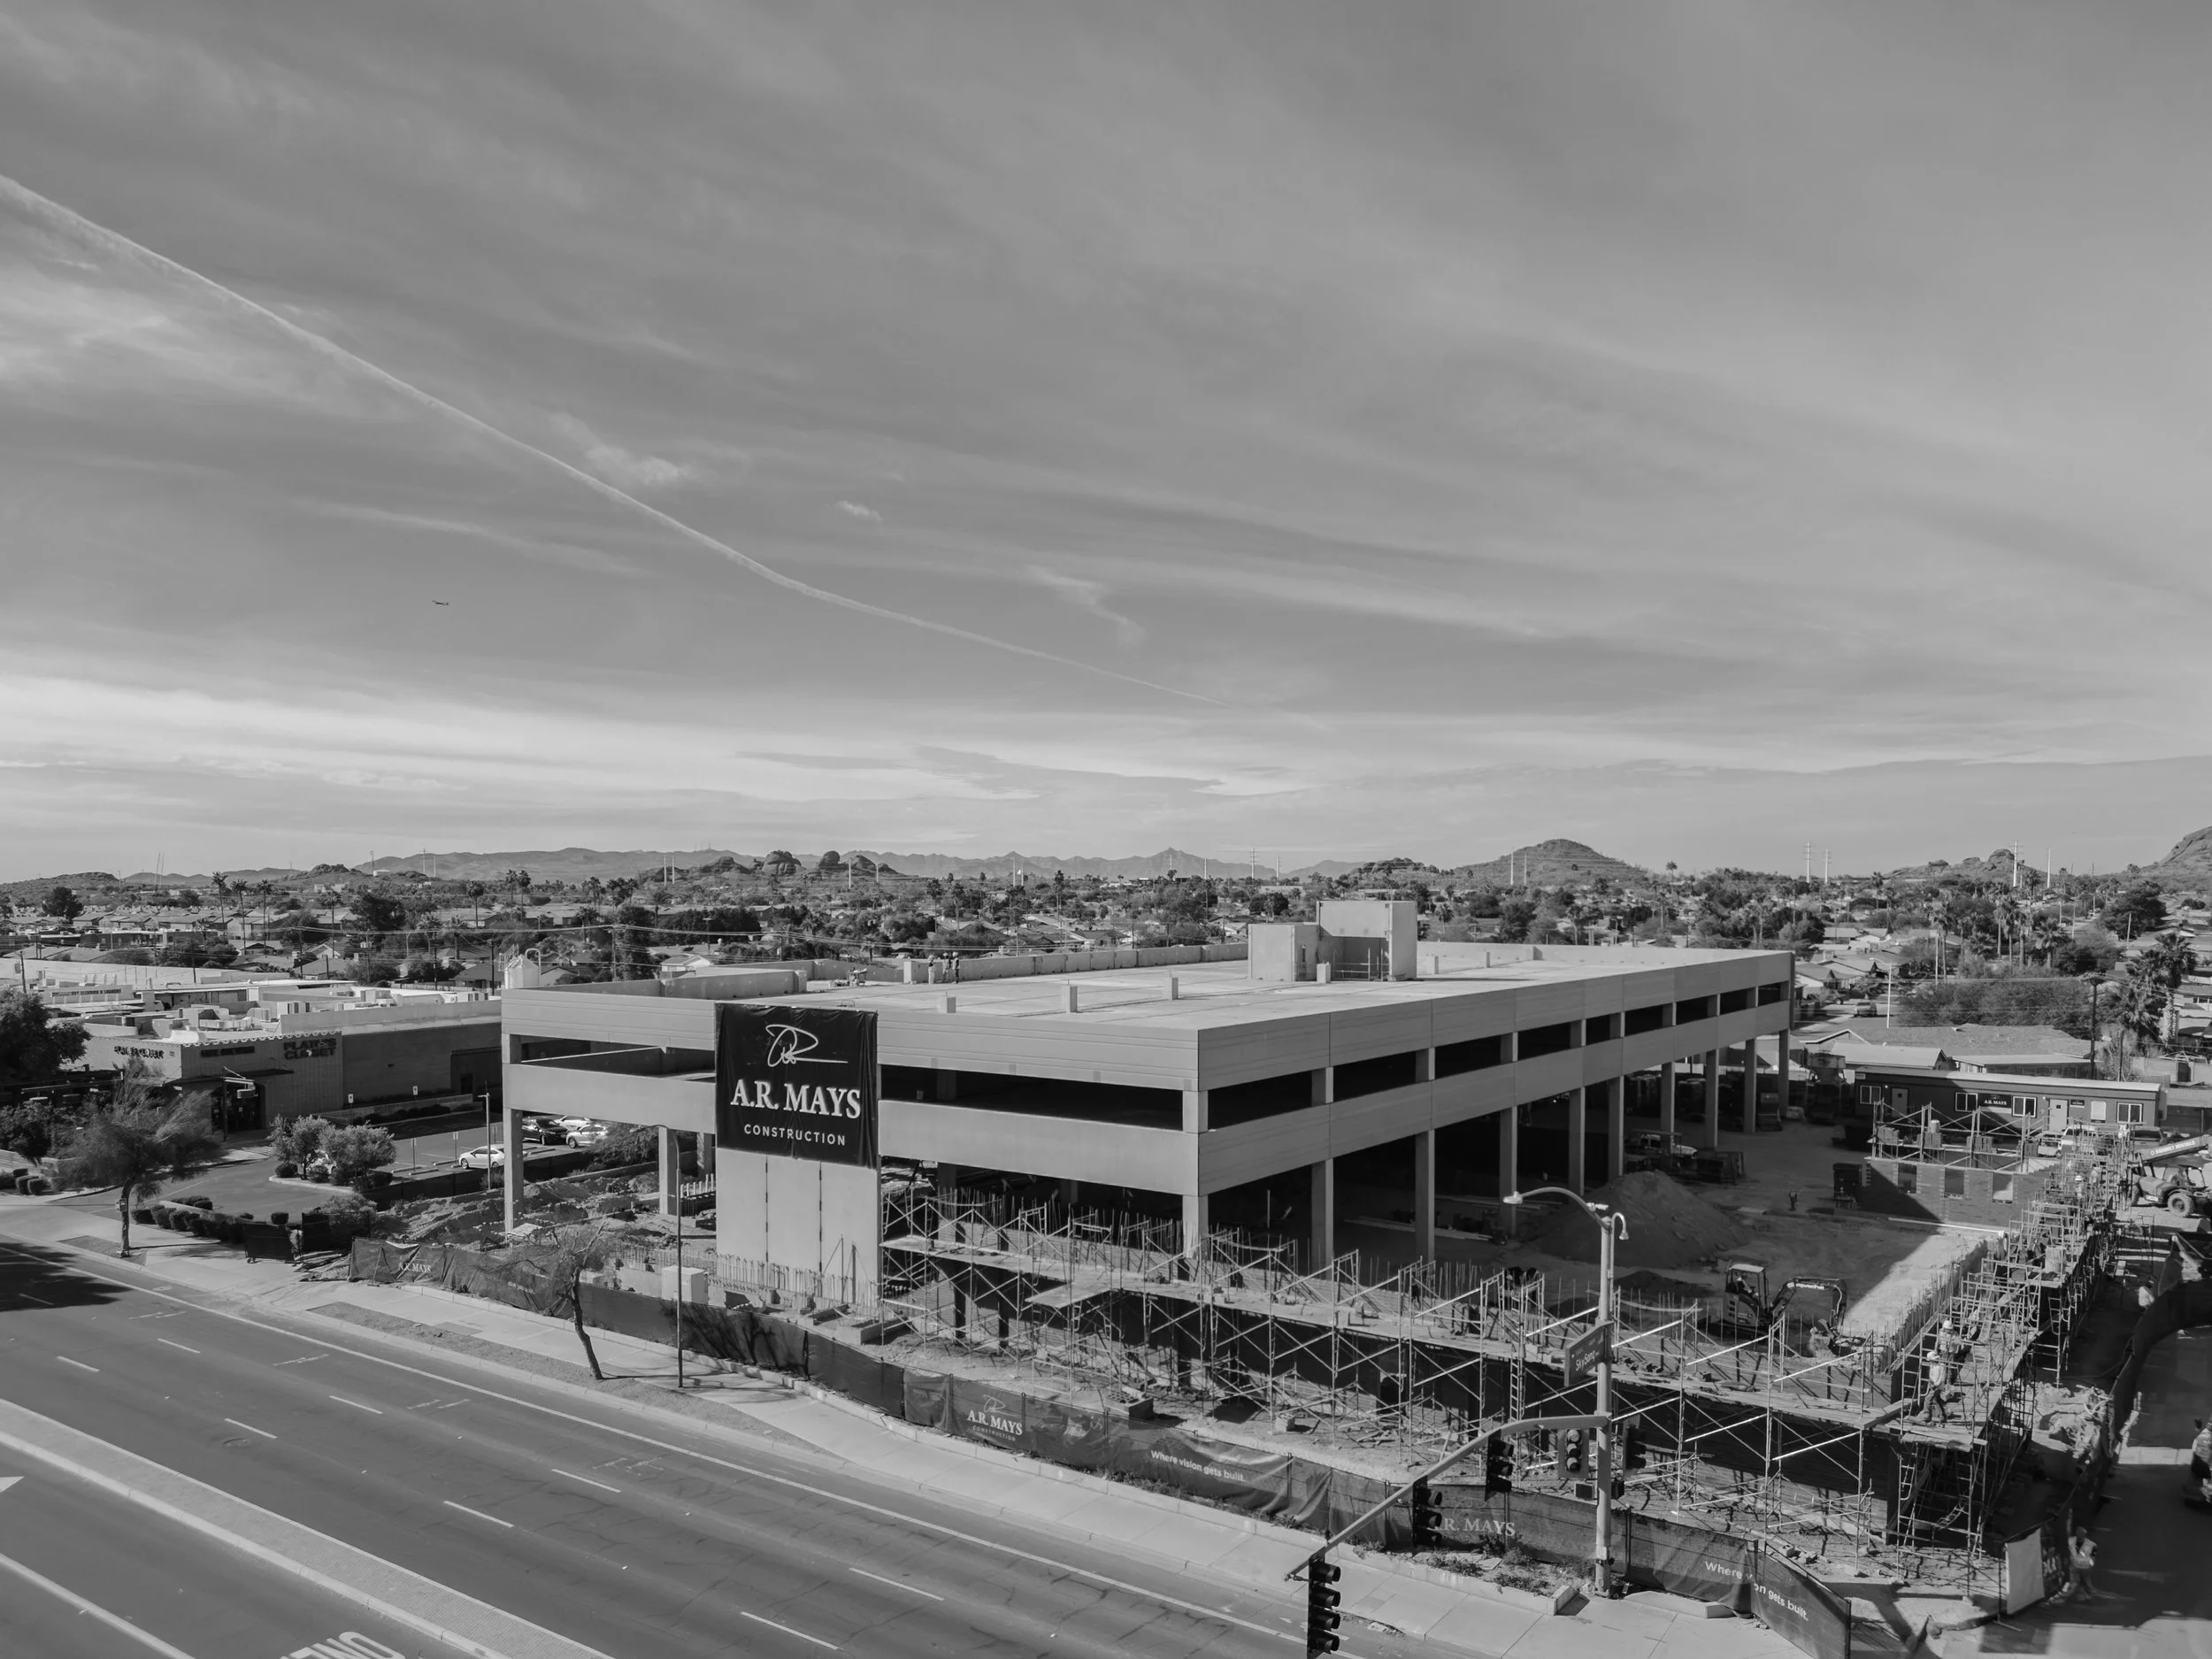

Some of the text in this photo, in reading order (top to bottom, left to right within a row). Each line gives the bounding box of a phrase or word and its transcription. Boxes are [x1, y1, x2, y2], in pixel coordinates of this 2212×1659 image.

[730, 1079, 861, 1118] A.R. MAYS
[744, 1124, 845, 1146] CONSTRUCTION
[990, 1416, 1023, 1436] MAYS
[1151, 1450, 1246, 1482] Where vision gets built.
[1463, 1518, 1516, 1537] MAYS
[1705, 1561, 1742, 1579] Where
[1768, 1590, 1786, 1608] gets
[1787, 1600, 1809, 1622] built.
